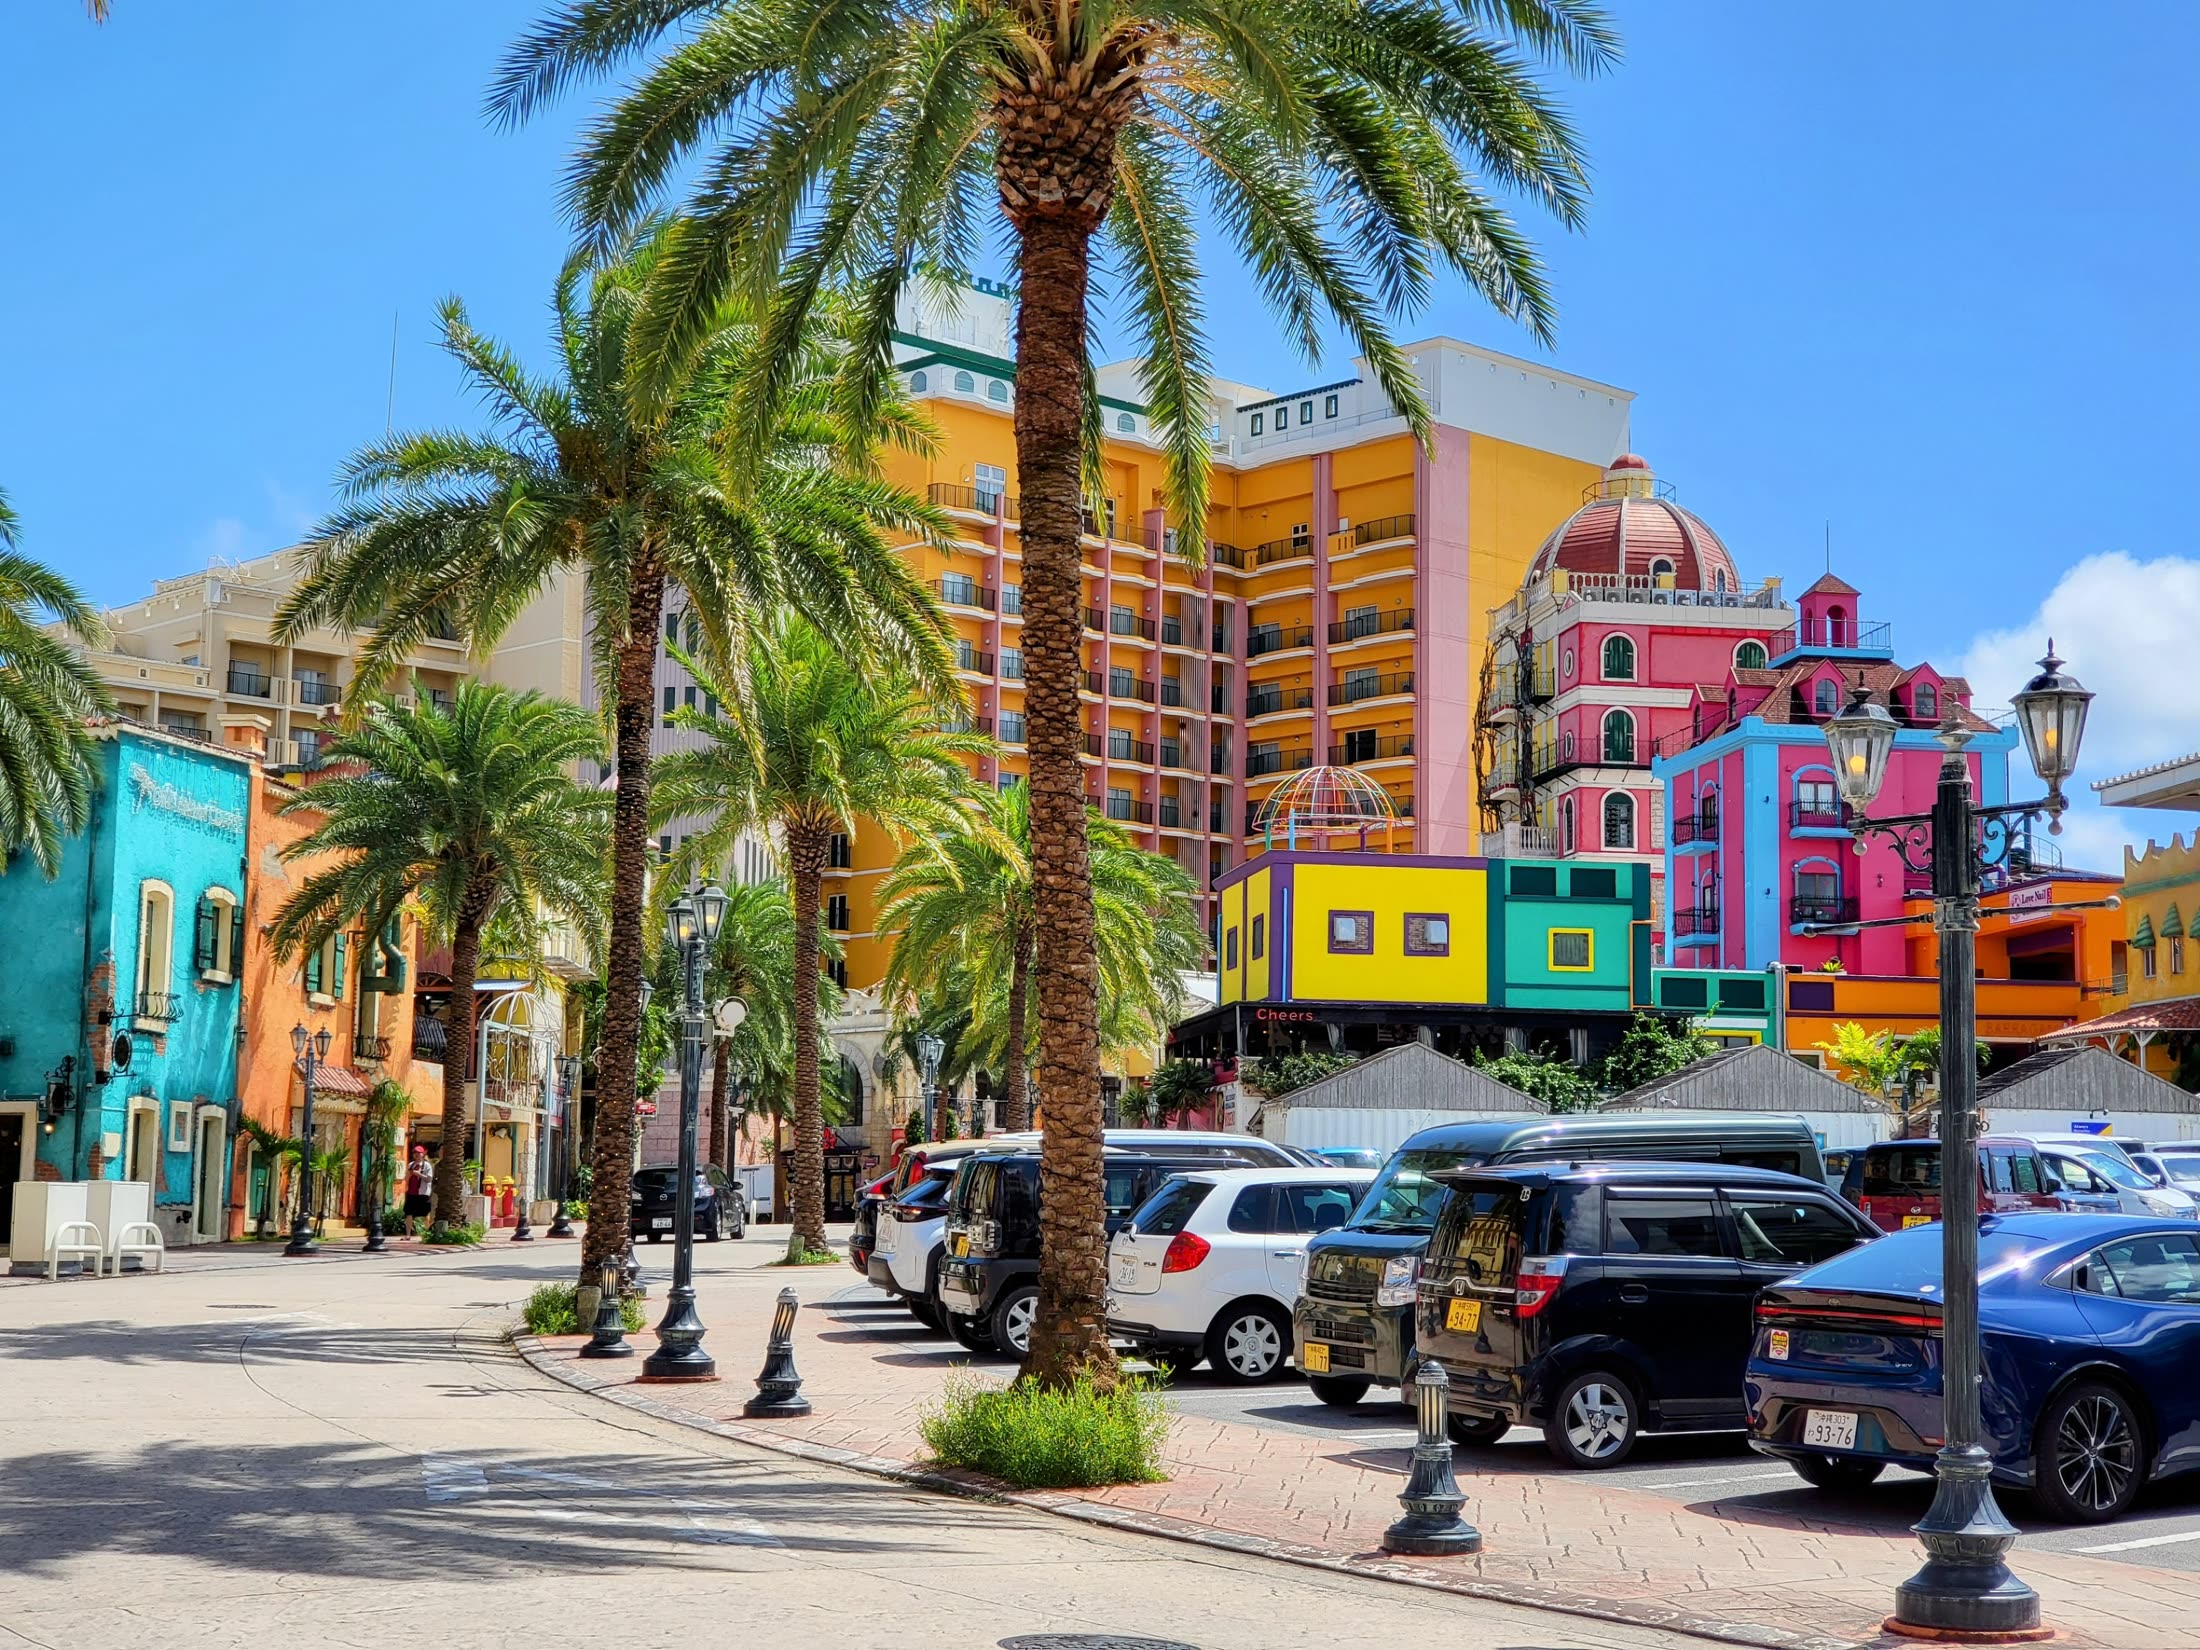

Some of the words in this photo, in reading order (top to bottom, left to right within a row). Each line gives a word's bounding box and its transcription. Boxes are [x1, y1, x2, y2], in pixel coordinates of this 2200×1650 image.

[2021, 894, 2034, 904] Love
[2034, 889, 2047, 902] Nail
[1256, 1008, 1314, 1021] Cheers
[1815, 1424, 1853, 1446] 93-76
